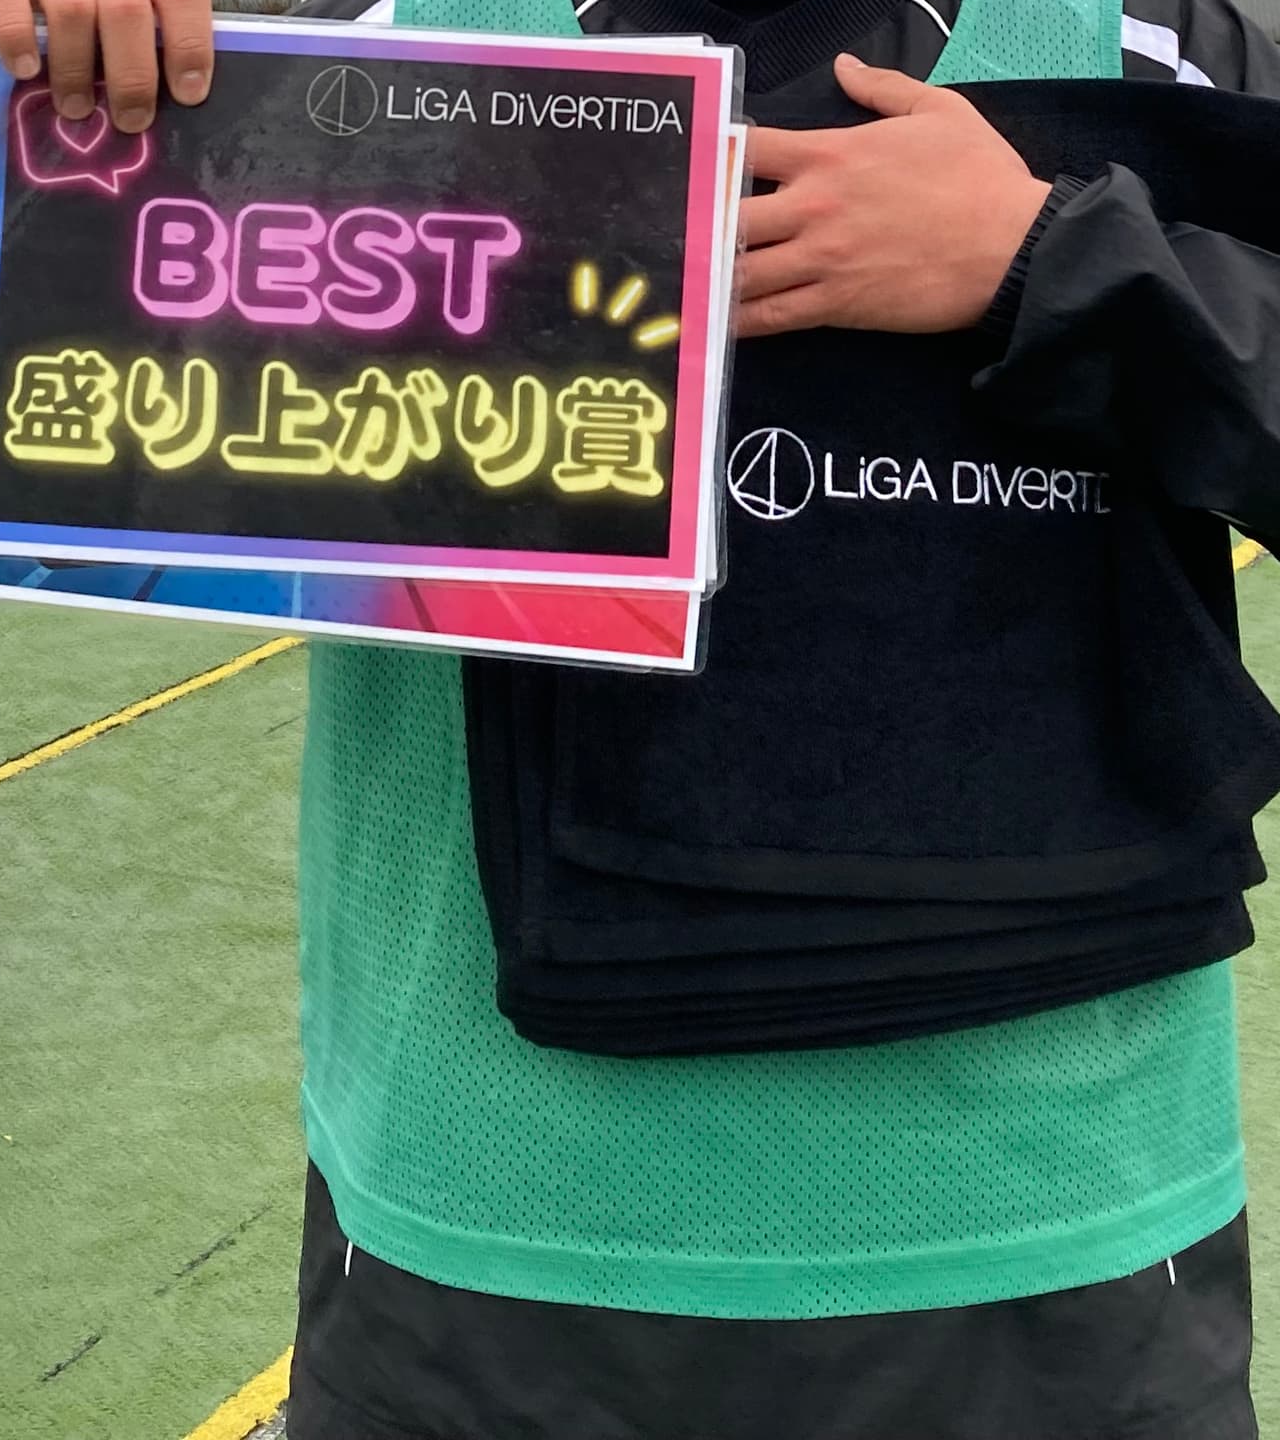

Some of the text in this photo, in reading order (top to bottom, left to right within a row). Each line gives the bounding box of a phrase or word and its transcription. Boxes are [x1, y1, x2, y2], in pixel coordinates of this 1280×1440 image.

[132, 197, 522, 336] BEST
[4, 347, 668, 498] 盛り上がり賞
